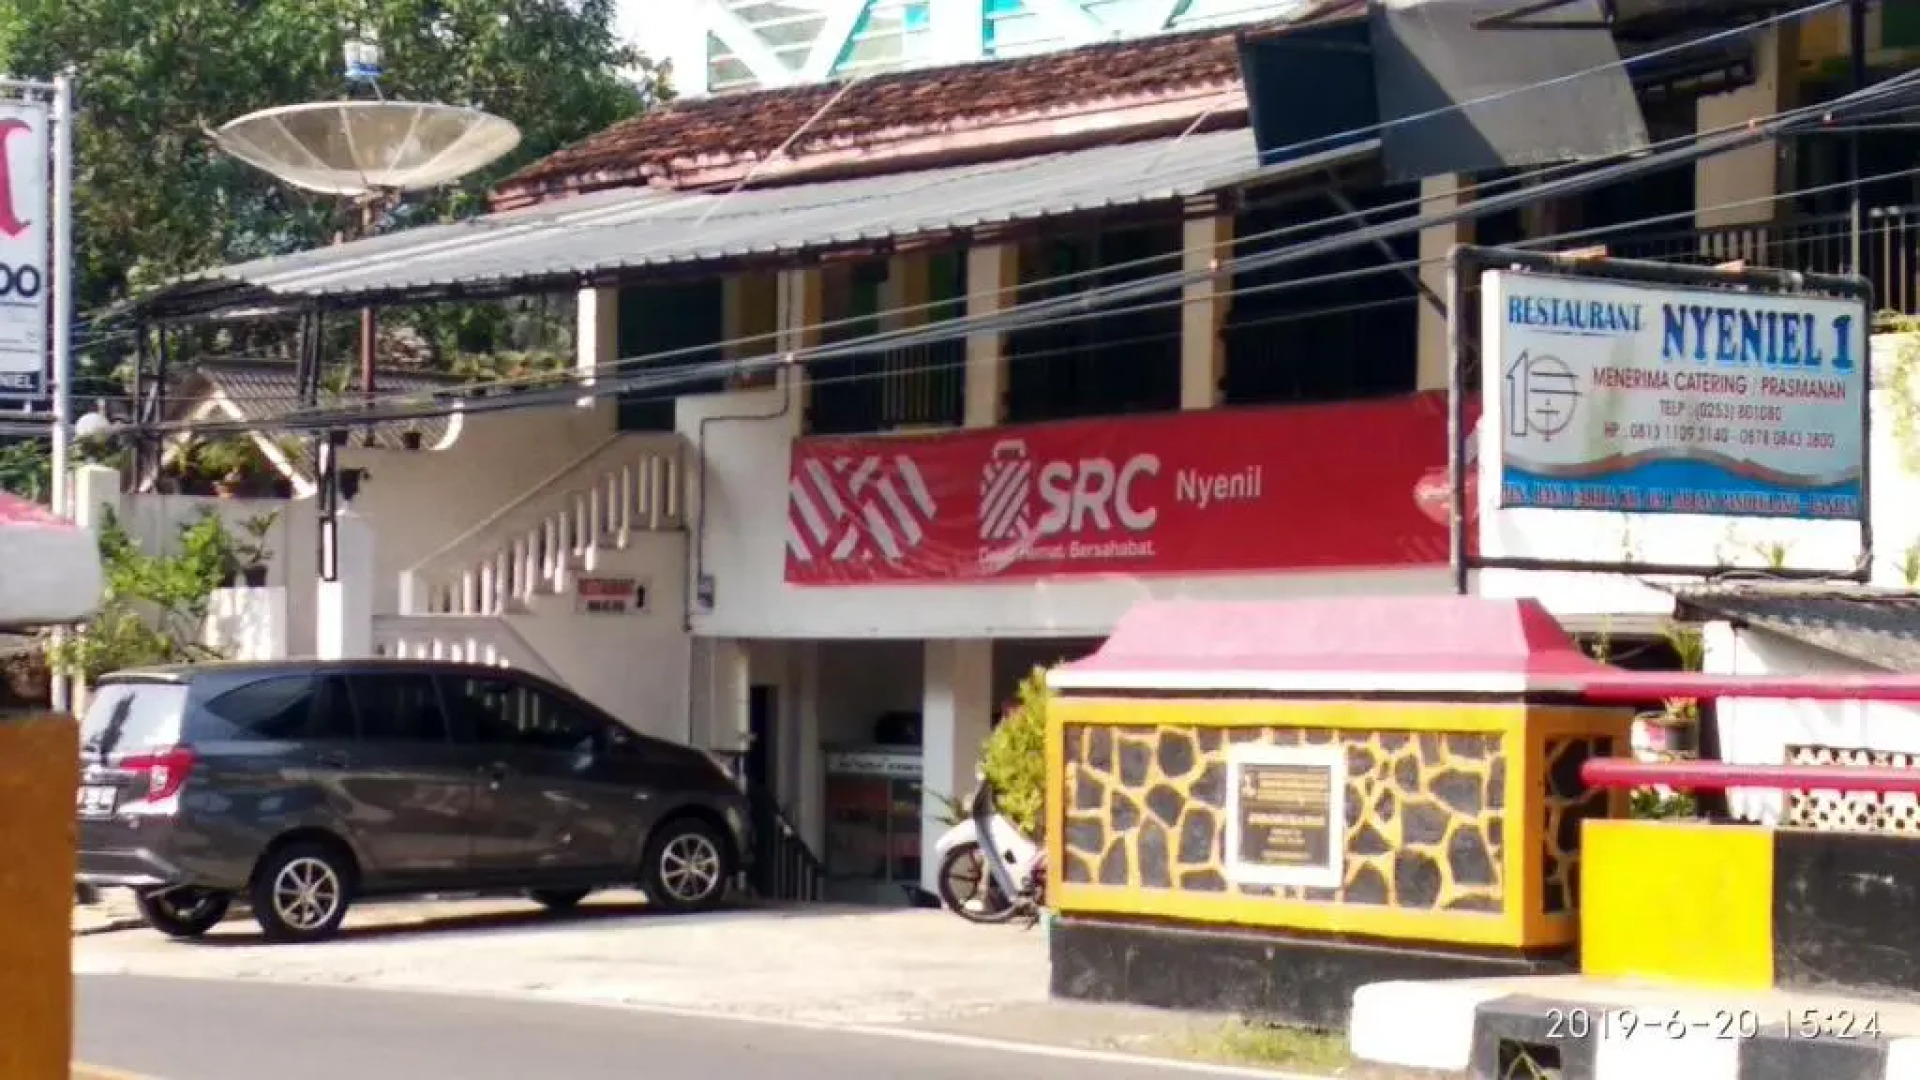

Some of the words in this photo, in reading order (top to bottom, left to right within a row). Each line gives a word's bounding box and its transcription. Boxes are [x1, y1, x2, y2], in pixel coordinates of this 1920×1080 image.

[1508, 294, 1643, 331] RESTAURANT
[1662, 303, 1823, 366] NYENIEL
[1831, 314, 1855, 371] 1
[1592, 365, 1671, 391] MENERIMA
[1674, 370, 1748, 395] CATERING
[1761, 375, 1847, 399] PRASMANAN
[1038, 453, 1162, 535] SRC
[1176, 464, 1263, 509] Nyenil
